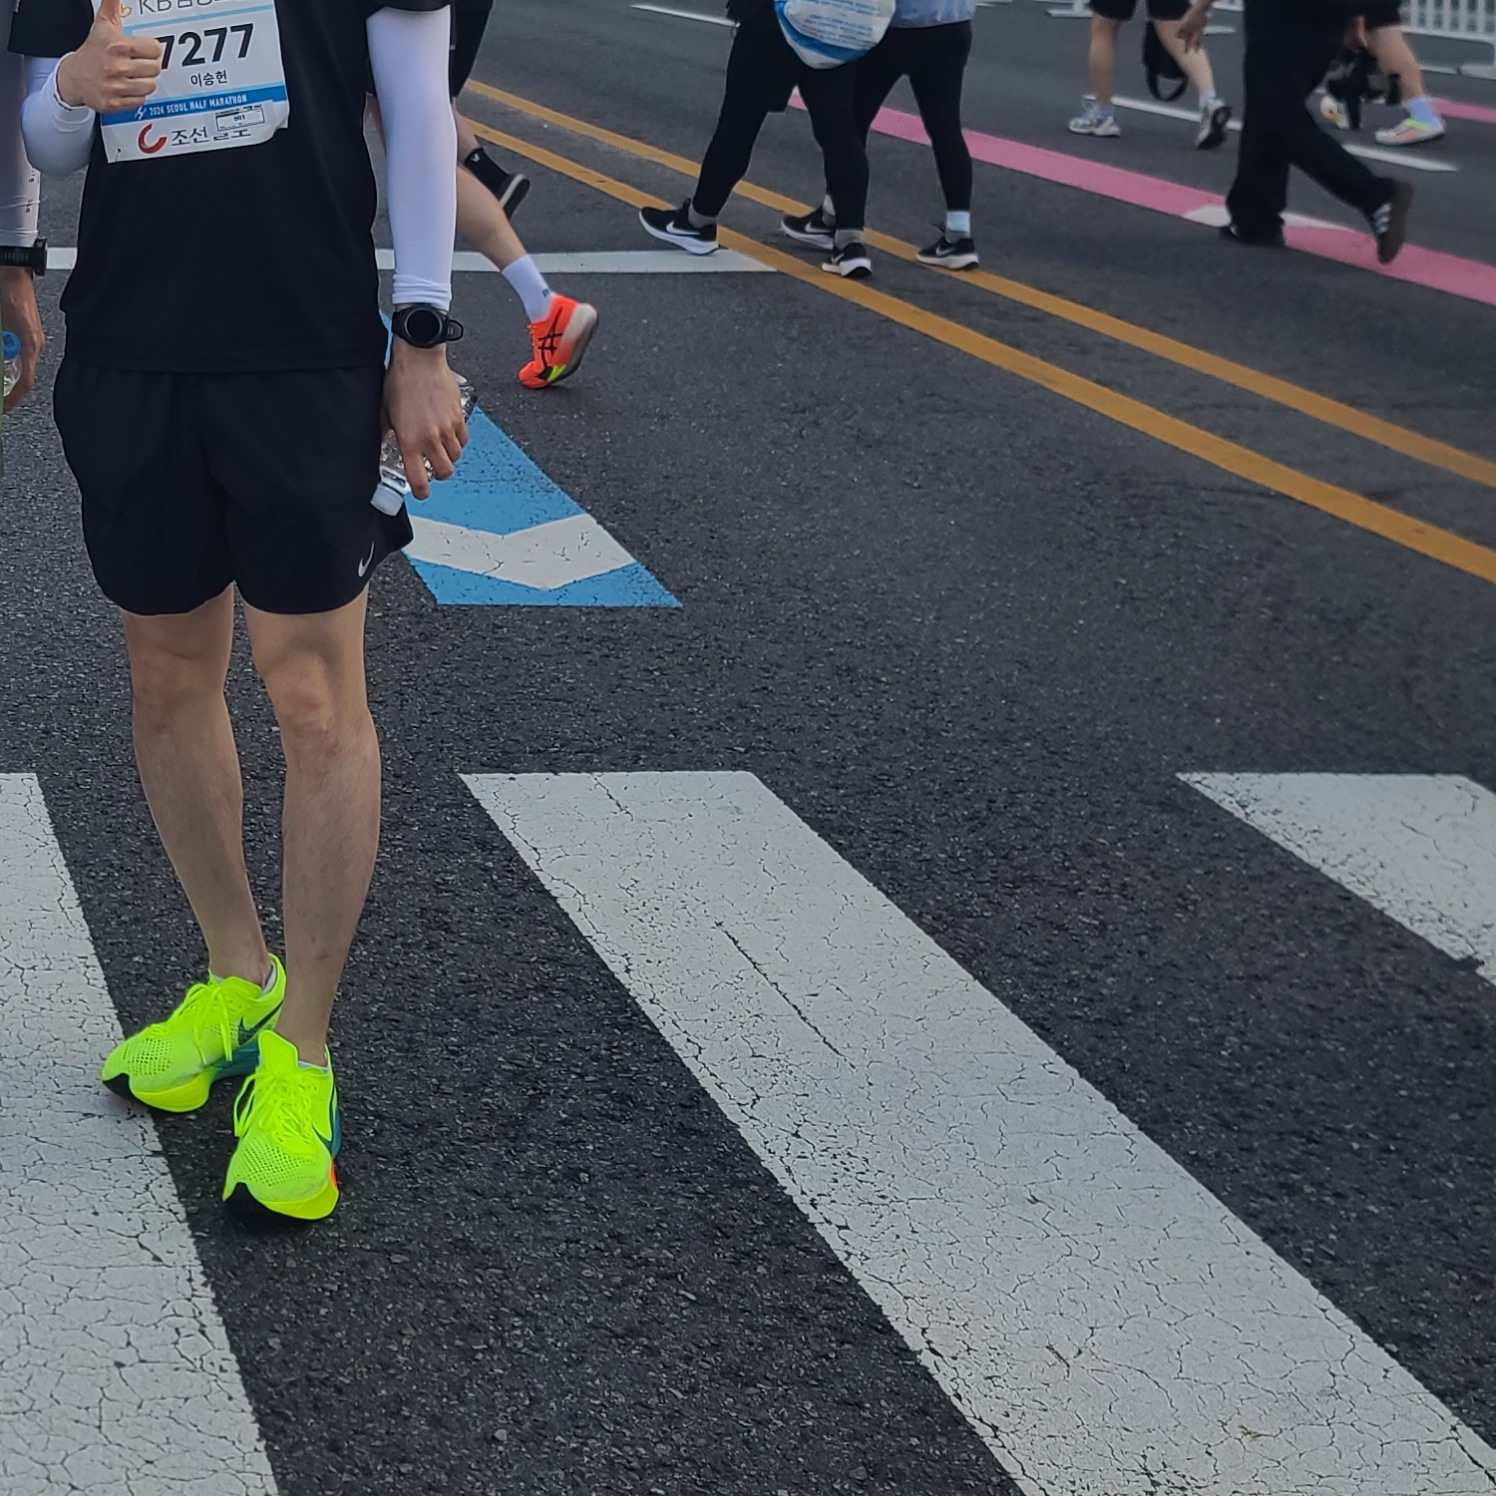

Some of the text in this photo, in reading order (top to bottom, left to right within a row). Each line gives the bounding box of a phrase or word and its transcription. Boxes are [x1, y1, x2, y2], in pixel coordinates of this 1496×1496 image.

[155, 23, 254, 70] 7277
[191, 70, 228, 87] 이승헌
[149, 94, 247, 115] 2024 SEOUL HALF MARATHON
